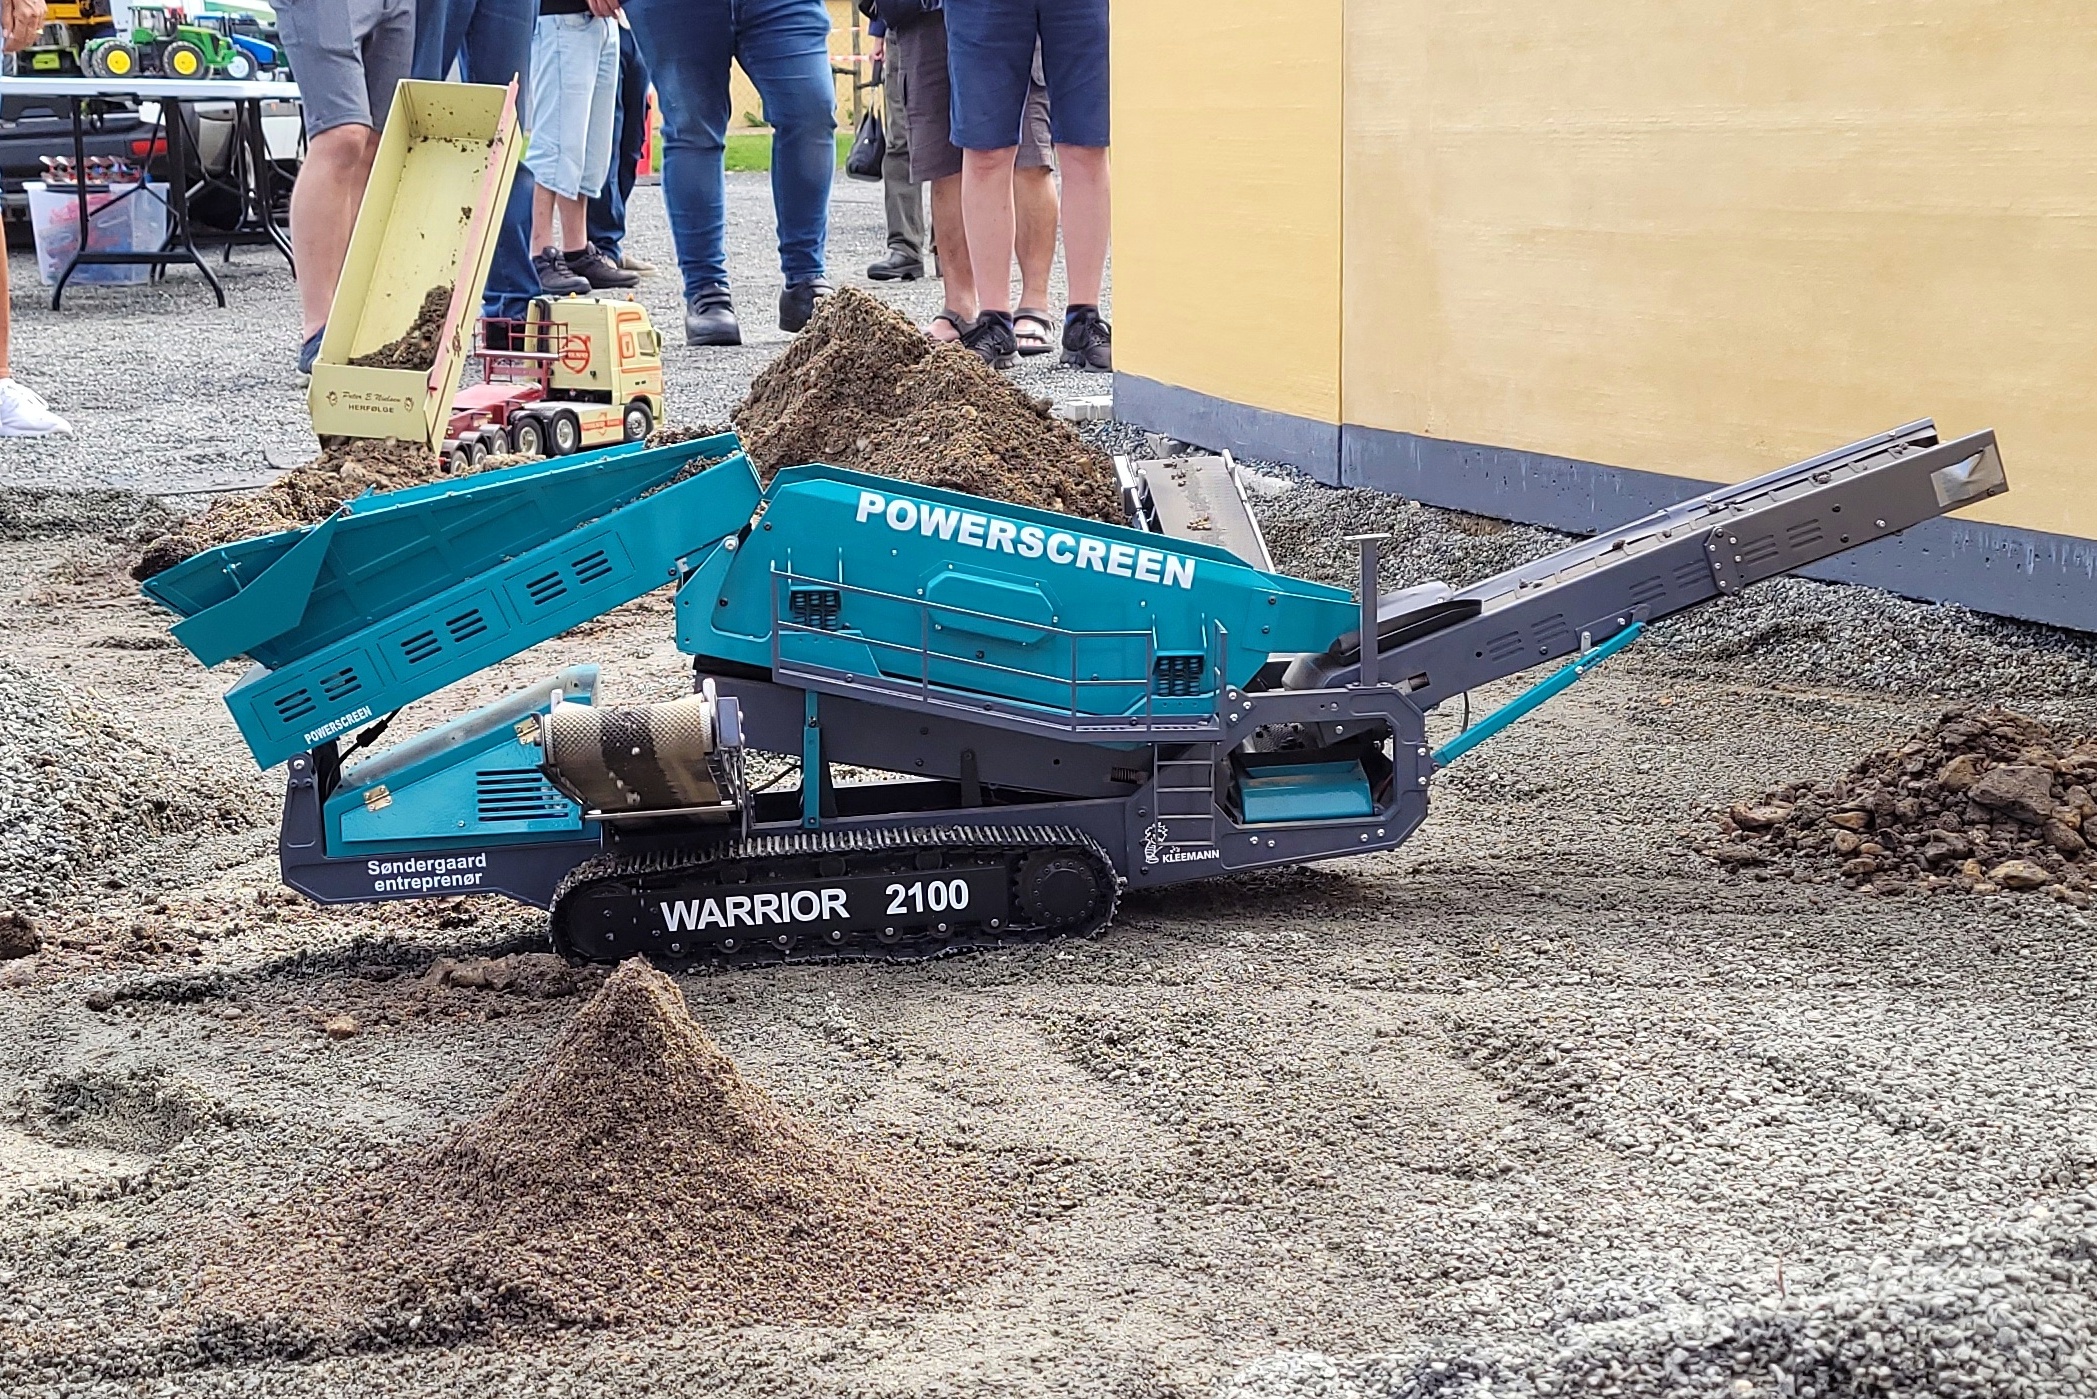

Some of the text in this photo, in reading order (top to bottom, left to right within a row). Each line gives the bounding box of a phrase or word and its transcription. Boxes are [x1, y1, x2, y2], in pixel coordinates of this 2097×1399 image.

[364, 392, 373, 401] E
[855, 491, 1196, 590] POWERSCREEN
[303, 705, 373, 745] POWERSCREEN
[367, 852, 487, 876] Søndergaard
[1162, 849, 1220, 864] KLEEMANN
[374, 872, 483, 892] entreprenør
[660, 879, 969, 932] WARRIOR 2100
